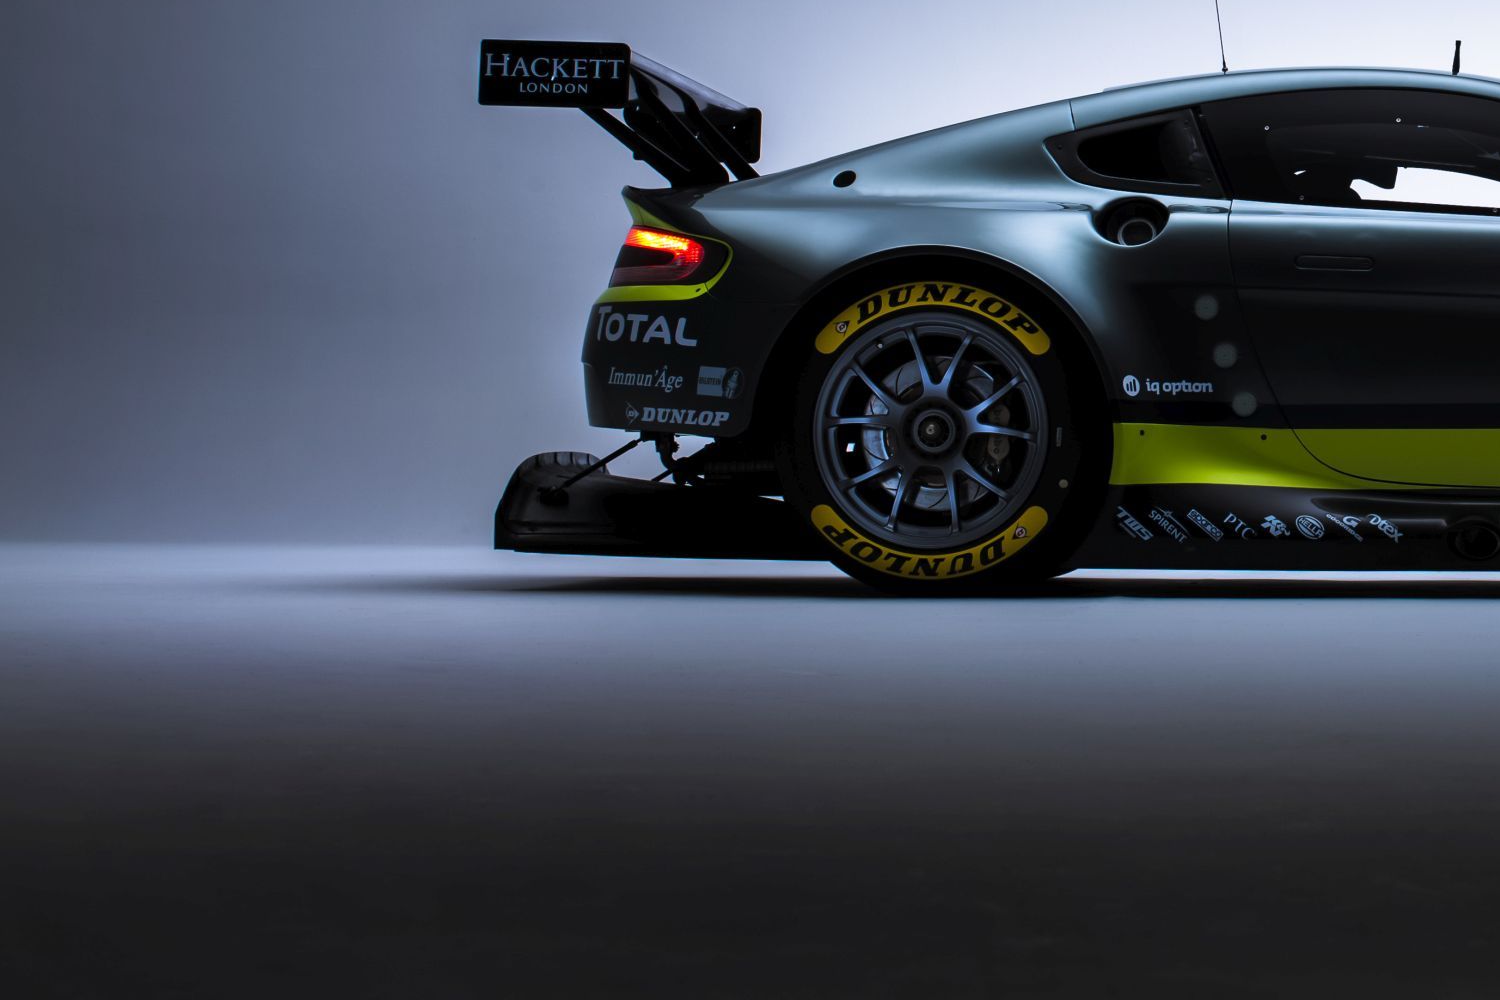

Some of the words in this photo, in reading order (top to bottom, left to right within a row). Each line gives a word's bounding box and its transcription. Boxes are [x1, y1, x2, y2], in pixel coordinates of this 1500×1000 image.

[484, 53, 625, 80] HACKETT
[519, 82, 589, 94] LONDON
[856, 283, 1038, 336] DUNLOP
[596, 305, 698, 347] TOTAL
[1146, 378, 1161, 396] iq
[1162, 380, 1213, 396] option
[640, 407, 731, 427] DUNLOP
[1148, 510, 1188, 544] SPIRENT
[824, 525, 1005, 577] DUNLOP
